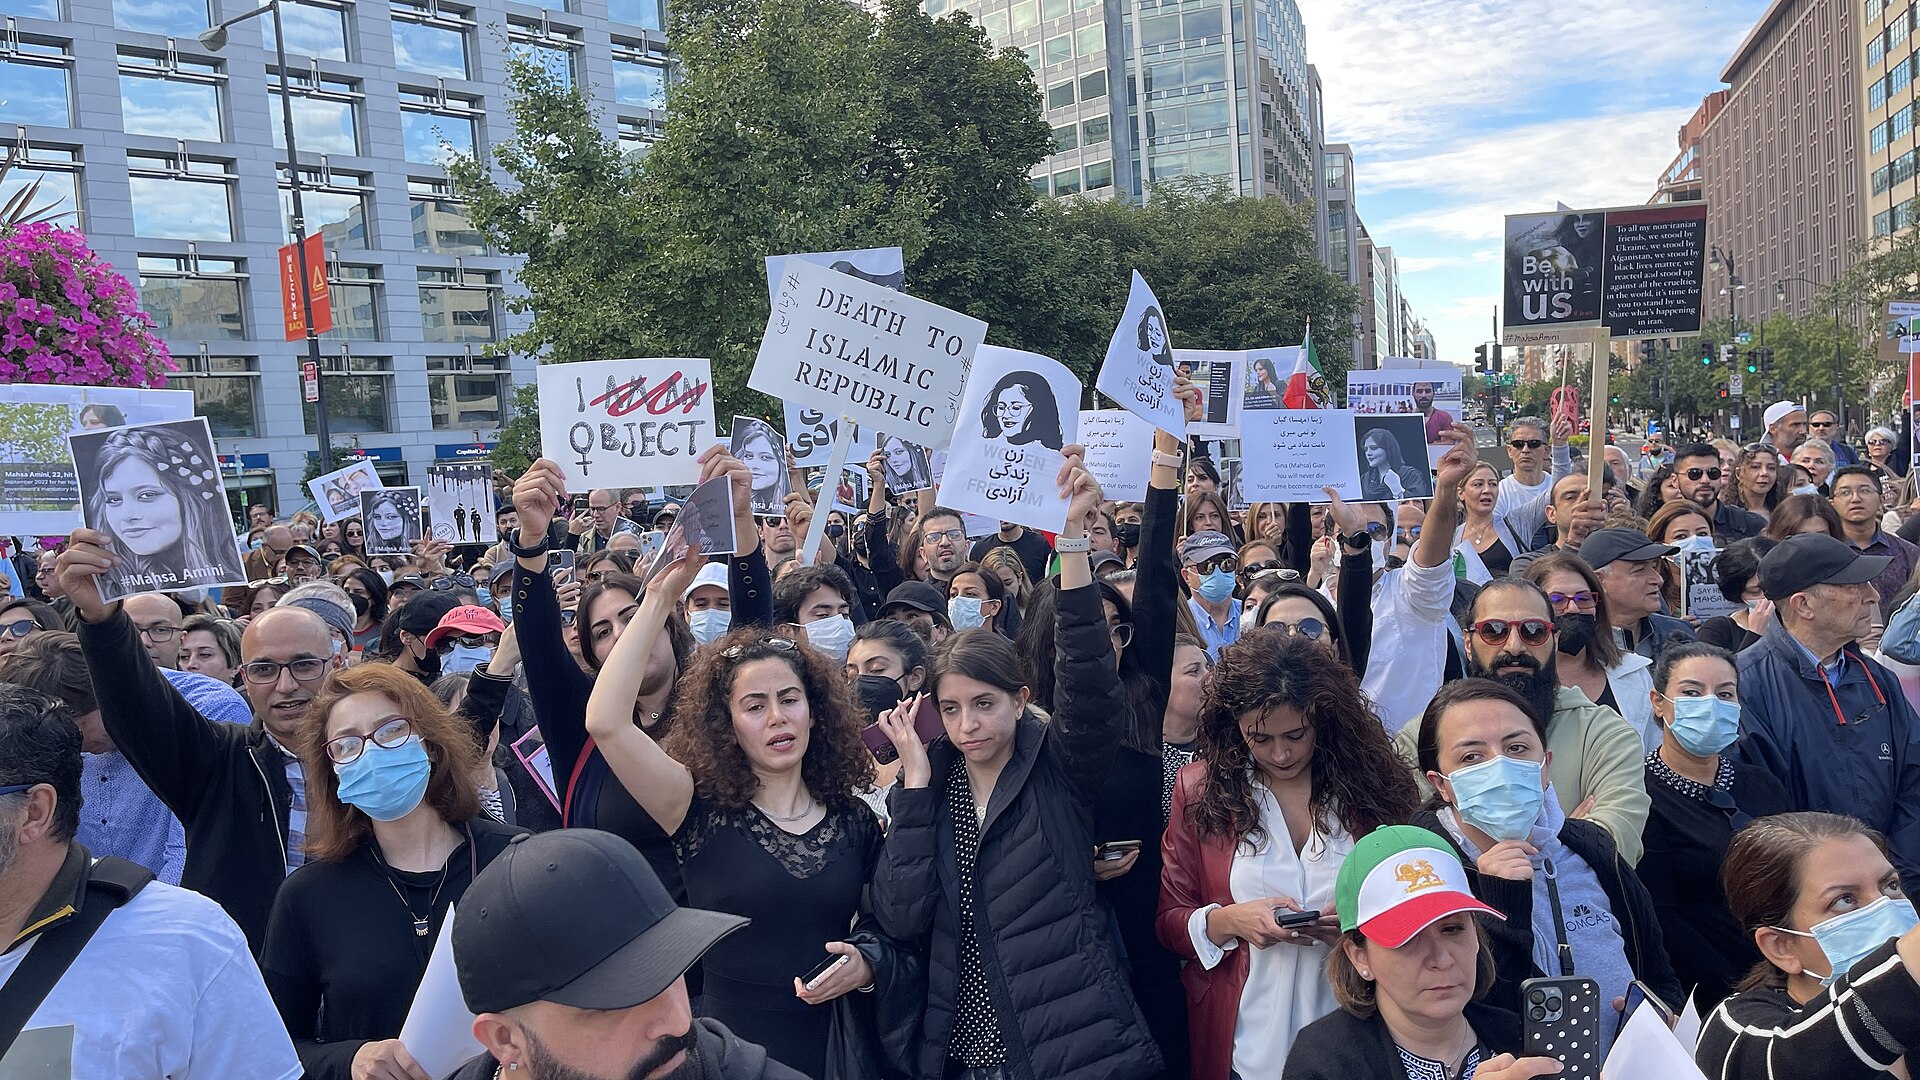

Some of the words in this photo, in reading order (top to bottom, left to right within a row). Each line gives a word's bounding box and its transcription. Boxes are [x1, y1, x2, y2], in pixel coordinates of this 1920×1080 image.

[1653, 222, 1696, 230] non-iranian
[1618, 234, 1646, 242] friends,
[1684, 230, 1694, 239] by
[1663, 240, 1684, 248] stood
[1686, 240, 1695, 248] by
[1610, 253, 1652, 262] Afganistan,
[1667, 249, 1688, 257] stood
[1690, 249, 1700, 258] by
[1522, 256, 1552, 275] Be
[1614, 262, 1634, 271] black
[1615, 271, 1643, 280] reacted
[1644, 270, 1658, 279] and
[1660, 269, 1681, 277] stood
[286, 254, 298, 320] WELCOME
[1522, 273, 1573, 292] with
[1610, 283, 1636, 292] against
[1523, 292, 1572, 320] us
[1656, 307, 1696, 316] happening
[1665, 298, 1675, 307] by
[288, 321, 304, 332] BACK
[816, 287, 907, 336] DEATH
[927, 326, 963, 356] TO
[805, 328, 935, 390] ISLAMIC
[1150, 366, 1162, 378] زن
[577, 376, 585, 412] I
[794, 361, 935, 427] REPUBLIC
[1139, 375, 1164, 398] زندگی
[1136, 391, 1161, 409] آزادی
[569, 420, 706, 476] OBJECT
[984, 444, 1045, 470] WOEN
[1005, 449, 1024, 463] زن
[989, 463, 1030, 486] زندگی
[986, 486, 1024, 504] آزادی
[120, 564, 224, 587] #Mahsa_Amini
[1566, 911, 1610, 932] OMCAS
